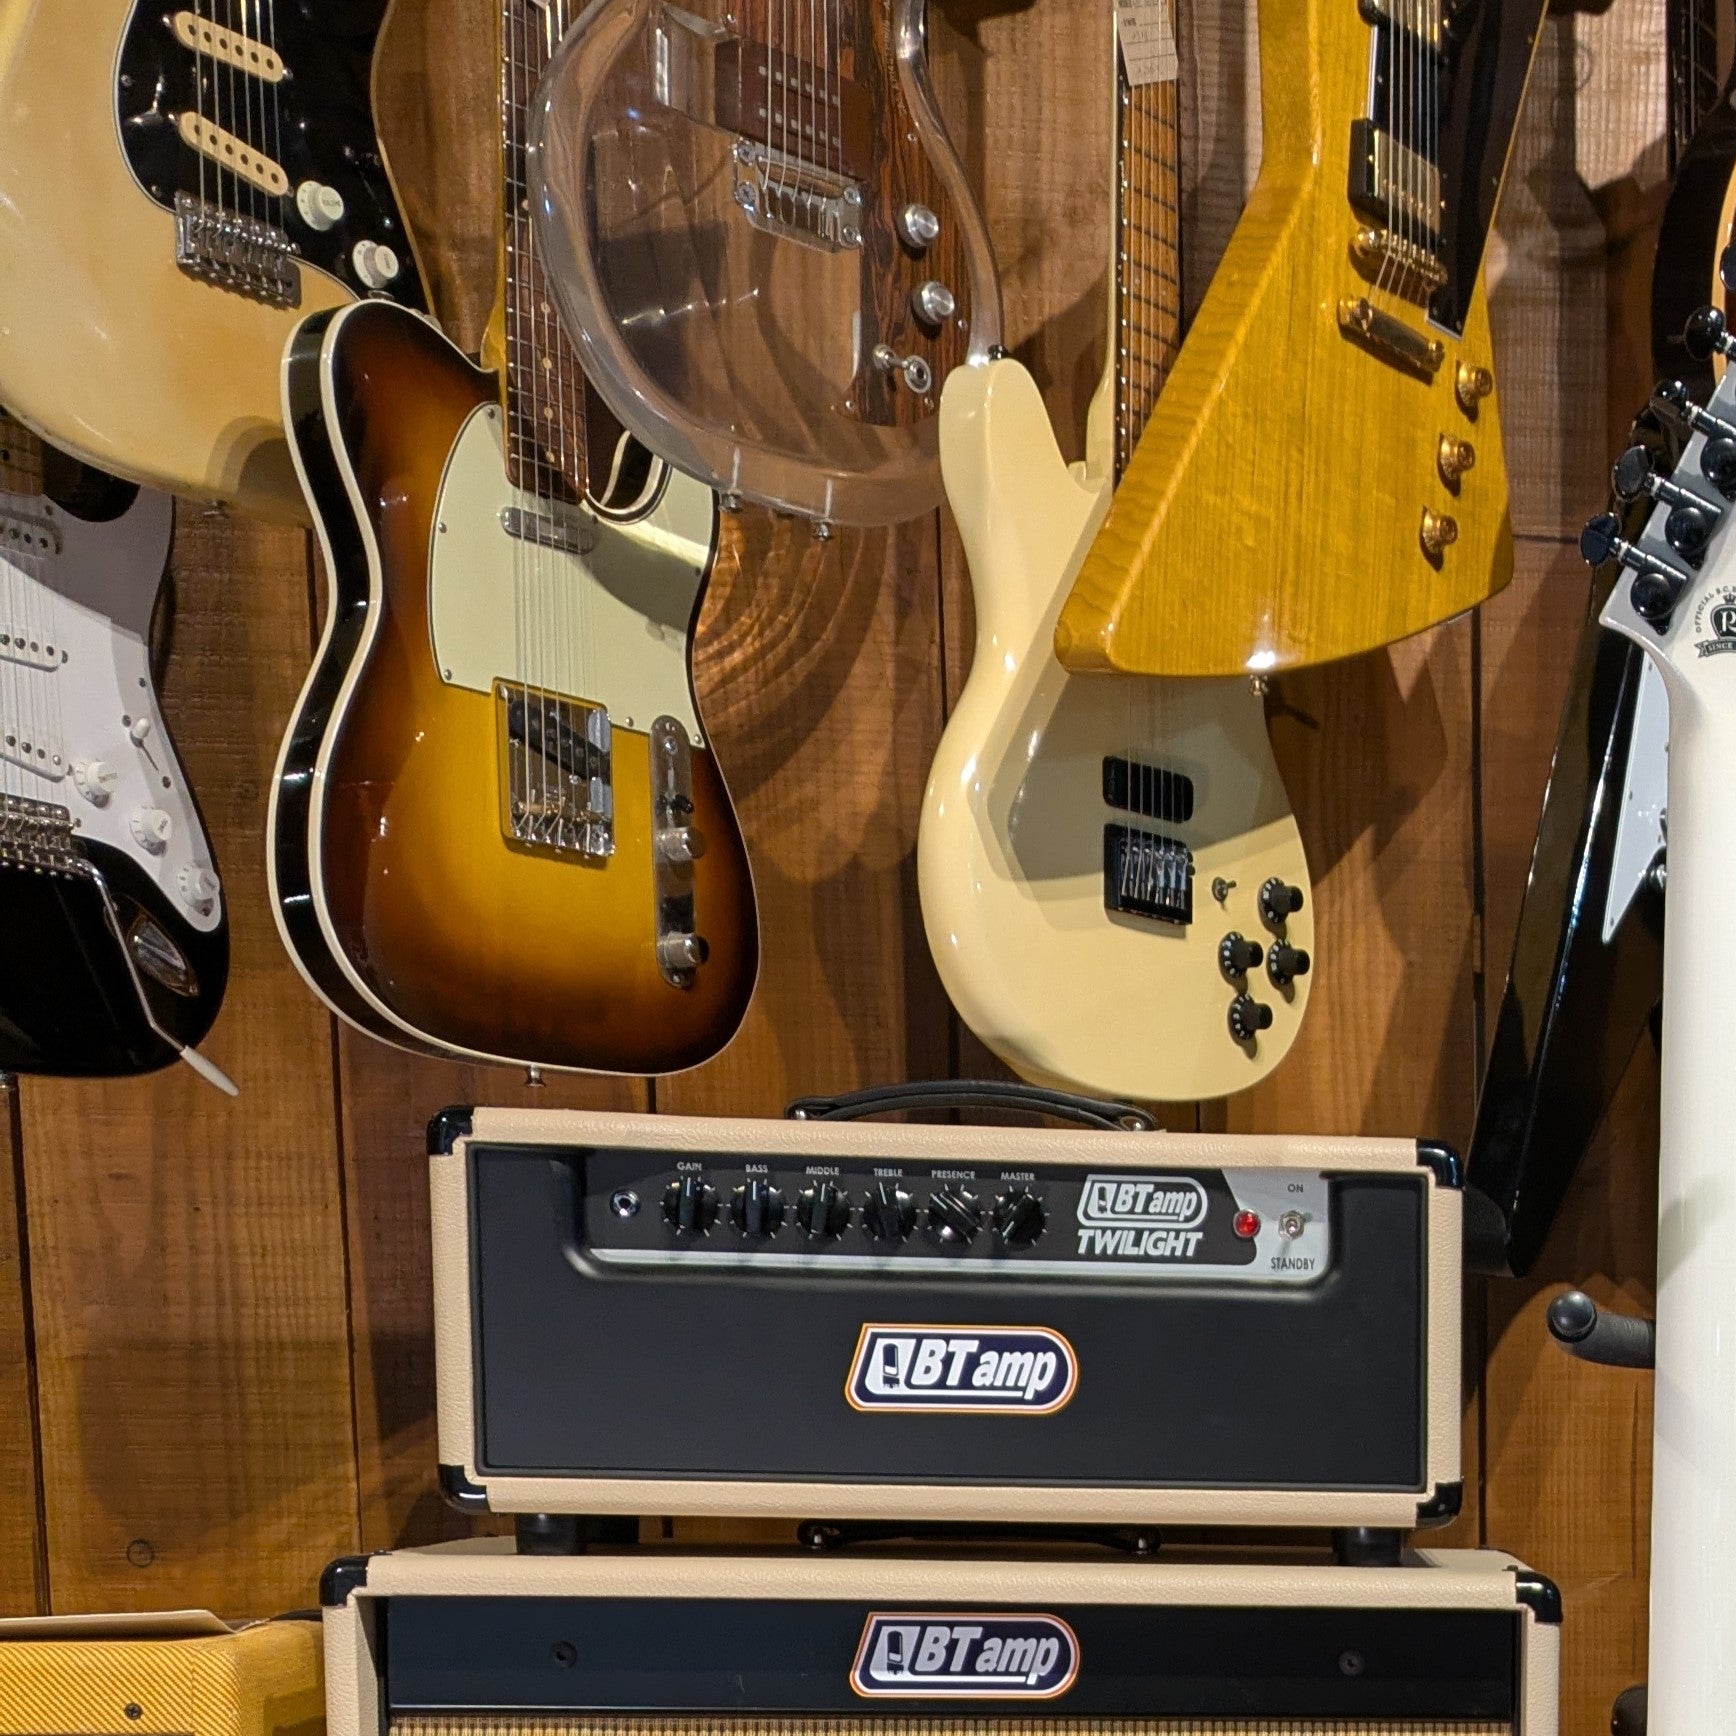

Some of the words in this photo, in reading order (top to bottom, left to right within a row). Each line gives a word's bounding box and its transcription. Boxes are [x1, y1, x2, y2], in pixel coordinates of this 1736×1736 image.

[1694, 592, 1715, 633] OFFICIAL
[677, 1162, 702, 1171] GAIN
[745, 1164, 768, 1173] BASS
[805, 1166, 840, 1176] MIDDLE
[873, 1168, 903, 1177] TREBLE
[931, 1169, 976, 1180] PRESENCE
[1000, 1172, 1036, 1181] MASTER
[1287, 1184, 1304, 1193] ON
[1114, 1182, 1155, 1213] BT
[1148, 1189, 1198, 1221] amp
[1077, 1229, 1203, 1257] TWILIGHT
[1270, 1257, 1315, 1270] STANDBY
[910, 1338, 980, 1386] BT
[971, 1350, 1057, 1400] amp
[914, 1625, 983, 1672] BT
[975, 1636, 1060, 1685] amp
